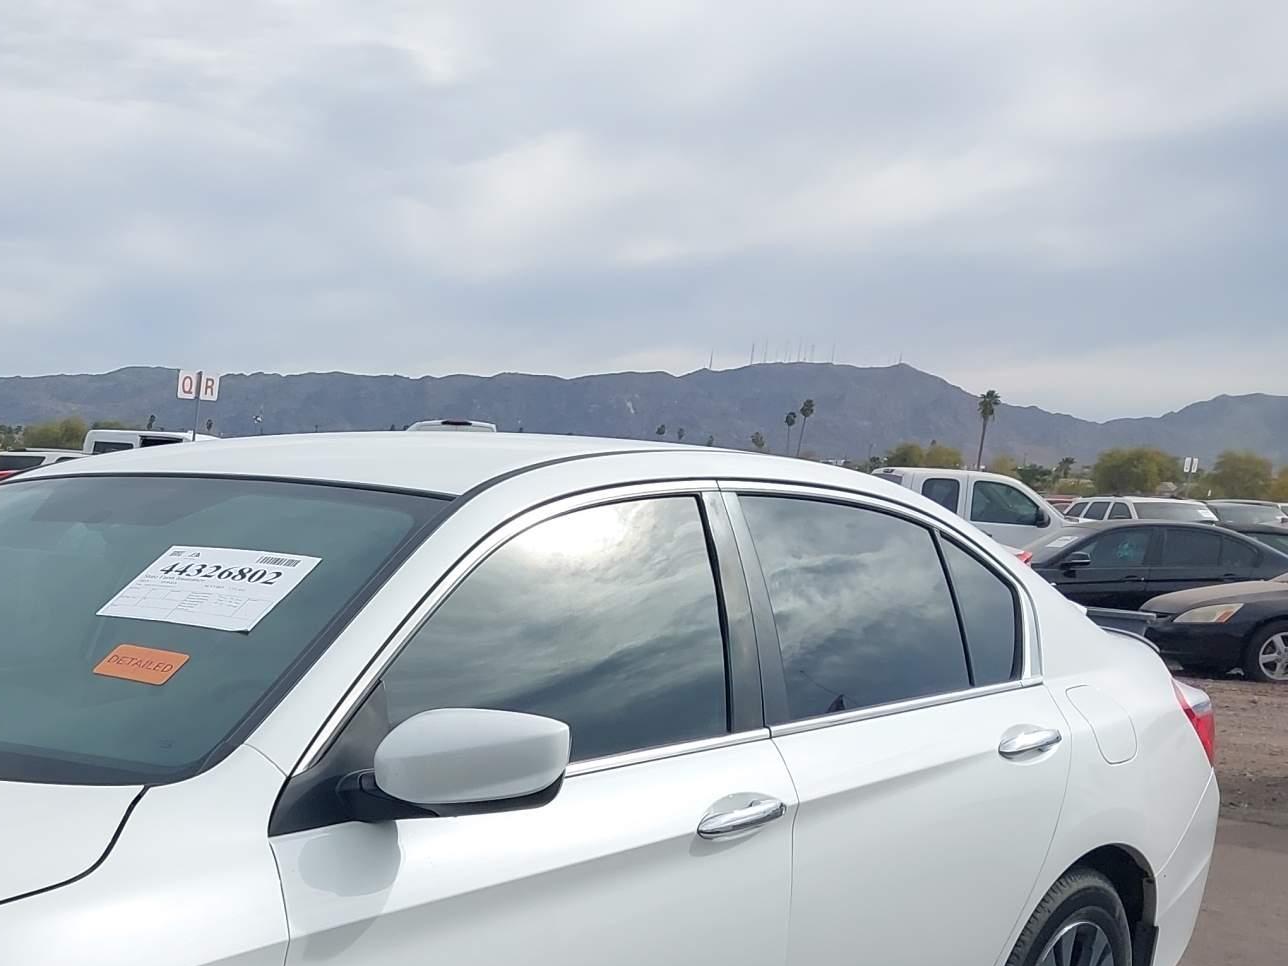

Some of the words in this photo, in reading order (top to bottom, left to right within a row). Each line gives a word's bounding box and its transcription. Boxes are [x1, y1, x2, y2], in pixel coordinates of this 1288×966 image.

[182, 375, 193, 395] Q
[204, 377, 215, 397] R
[159, 561, 282, 585] 44326802
[107, 654, 174, 673] DETAILED
